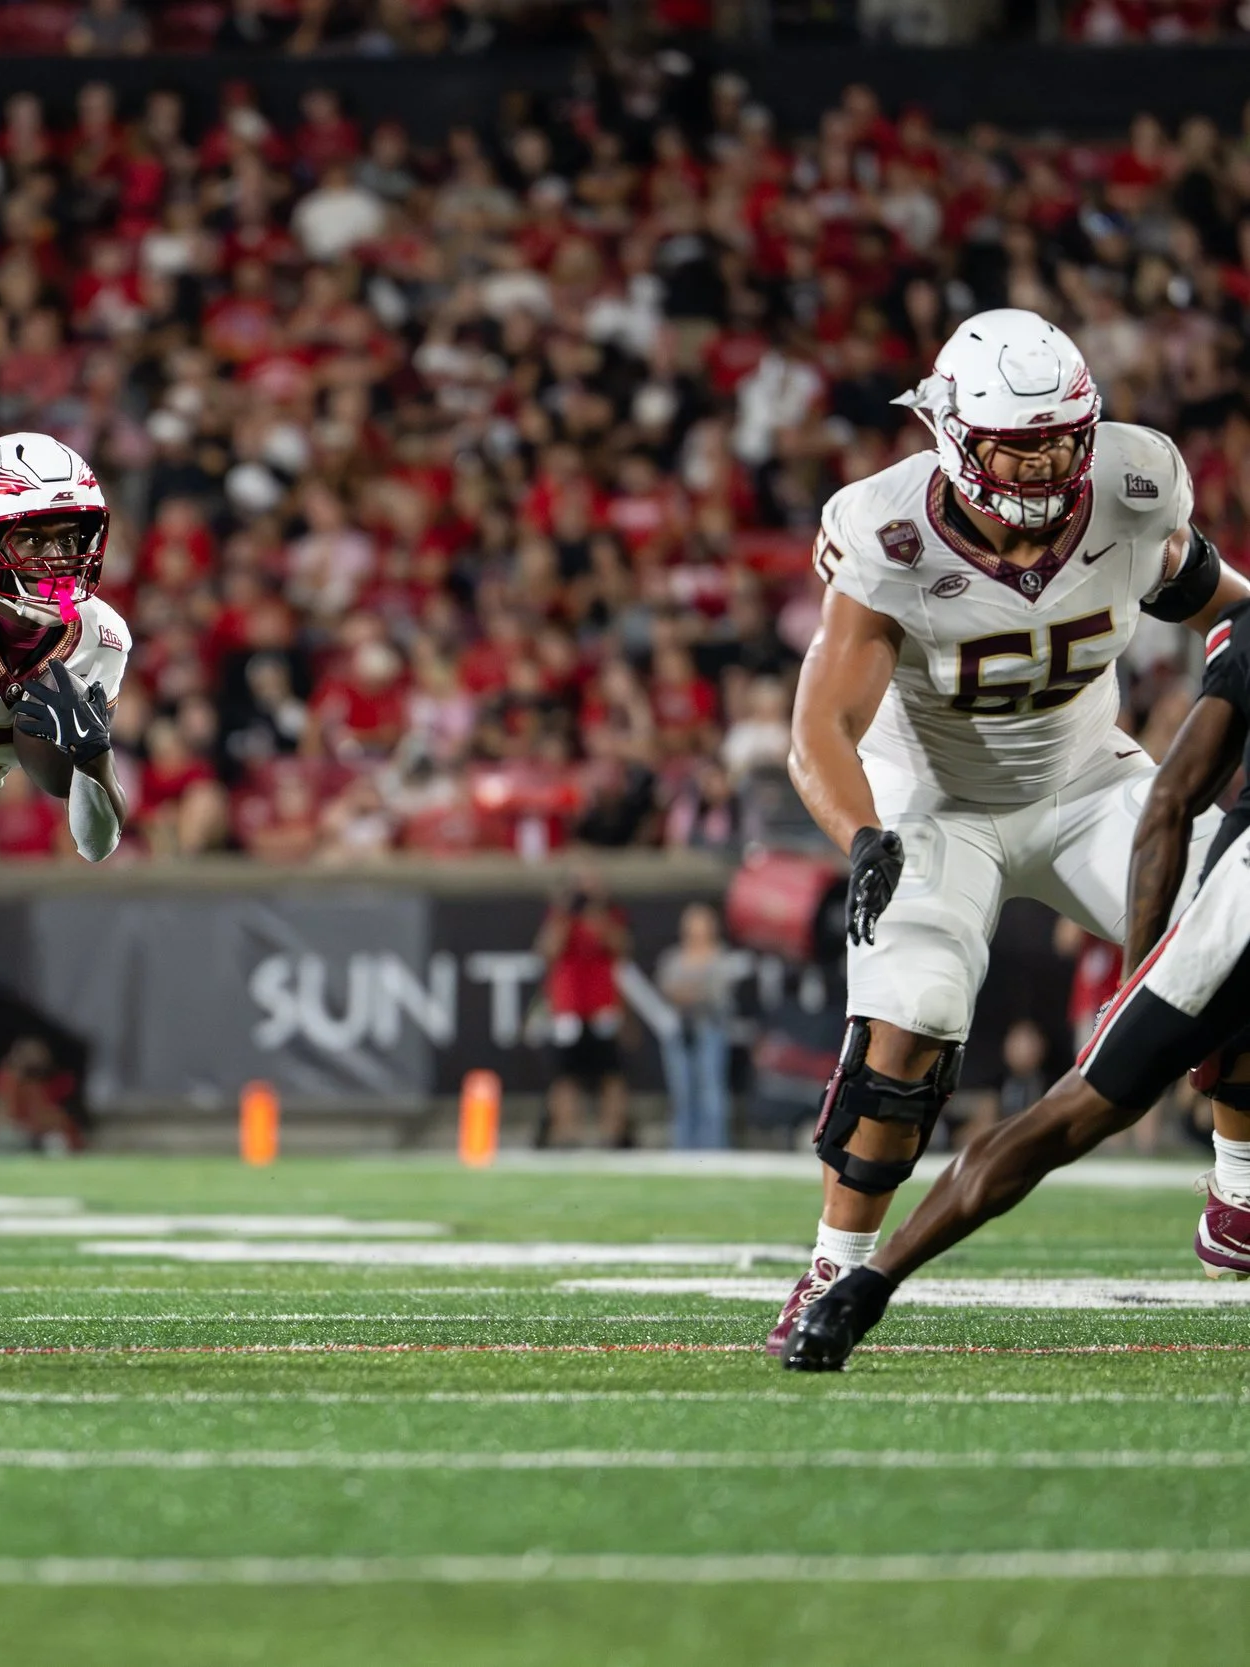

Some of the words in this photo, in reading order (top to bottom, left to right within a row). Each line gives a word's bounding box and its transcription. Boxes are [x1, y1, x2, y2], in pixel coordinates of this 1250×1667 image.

[50, 491, 75, 502] ACC
[952, 606, 1116, 717] 65
[251, 949, 458, 1050] SUN
